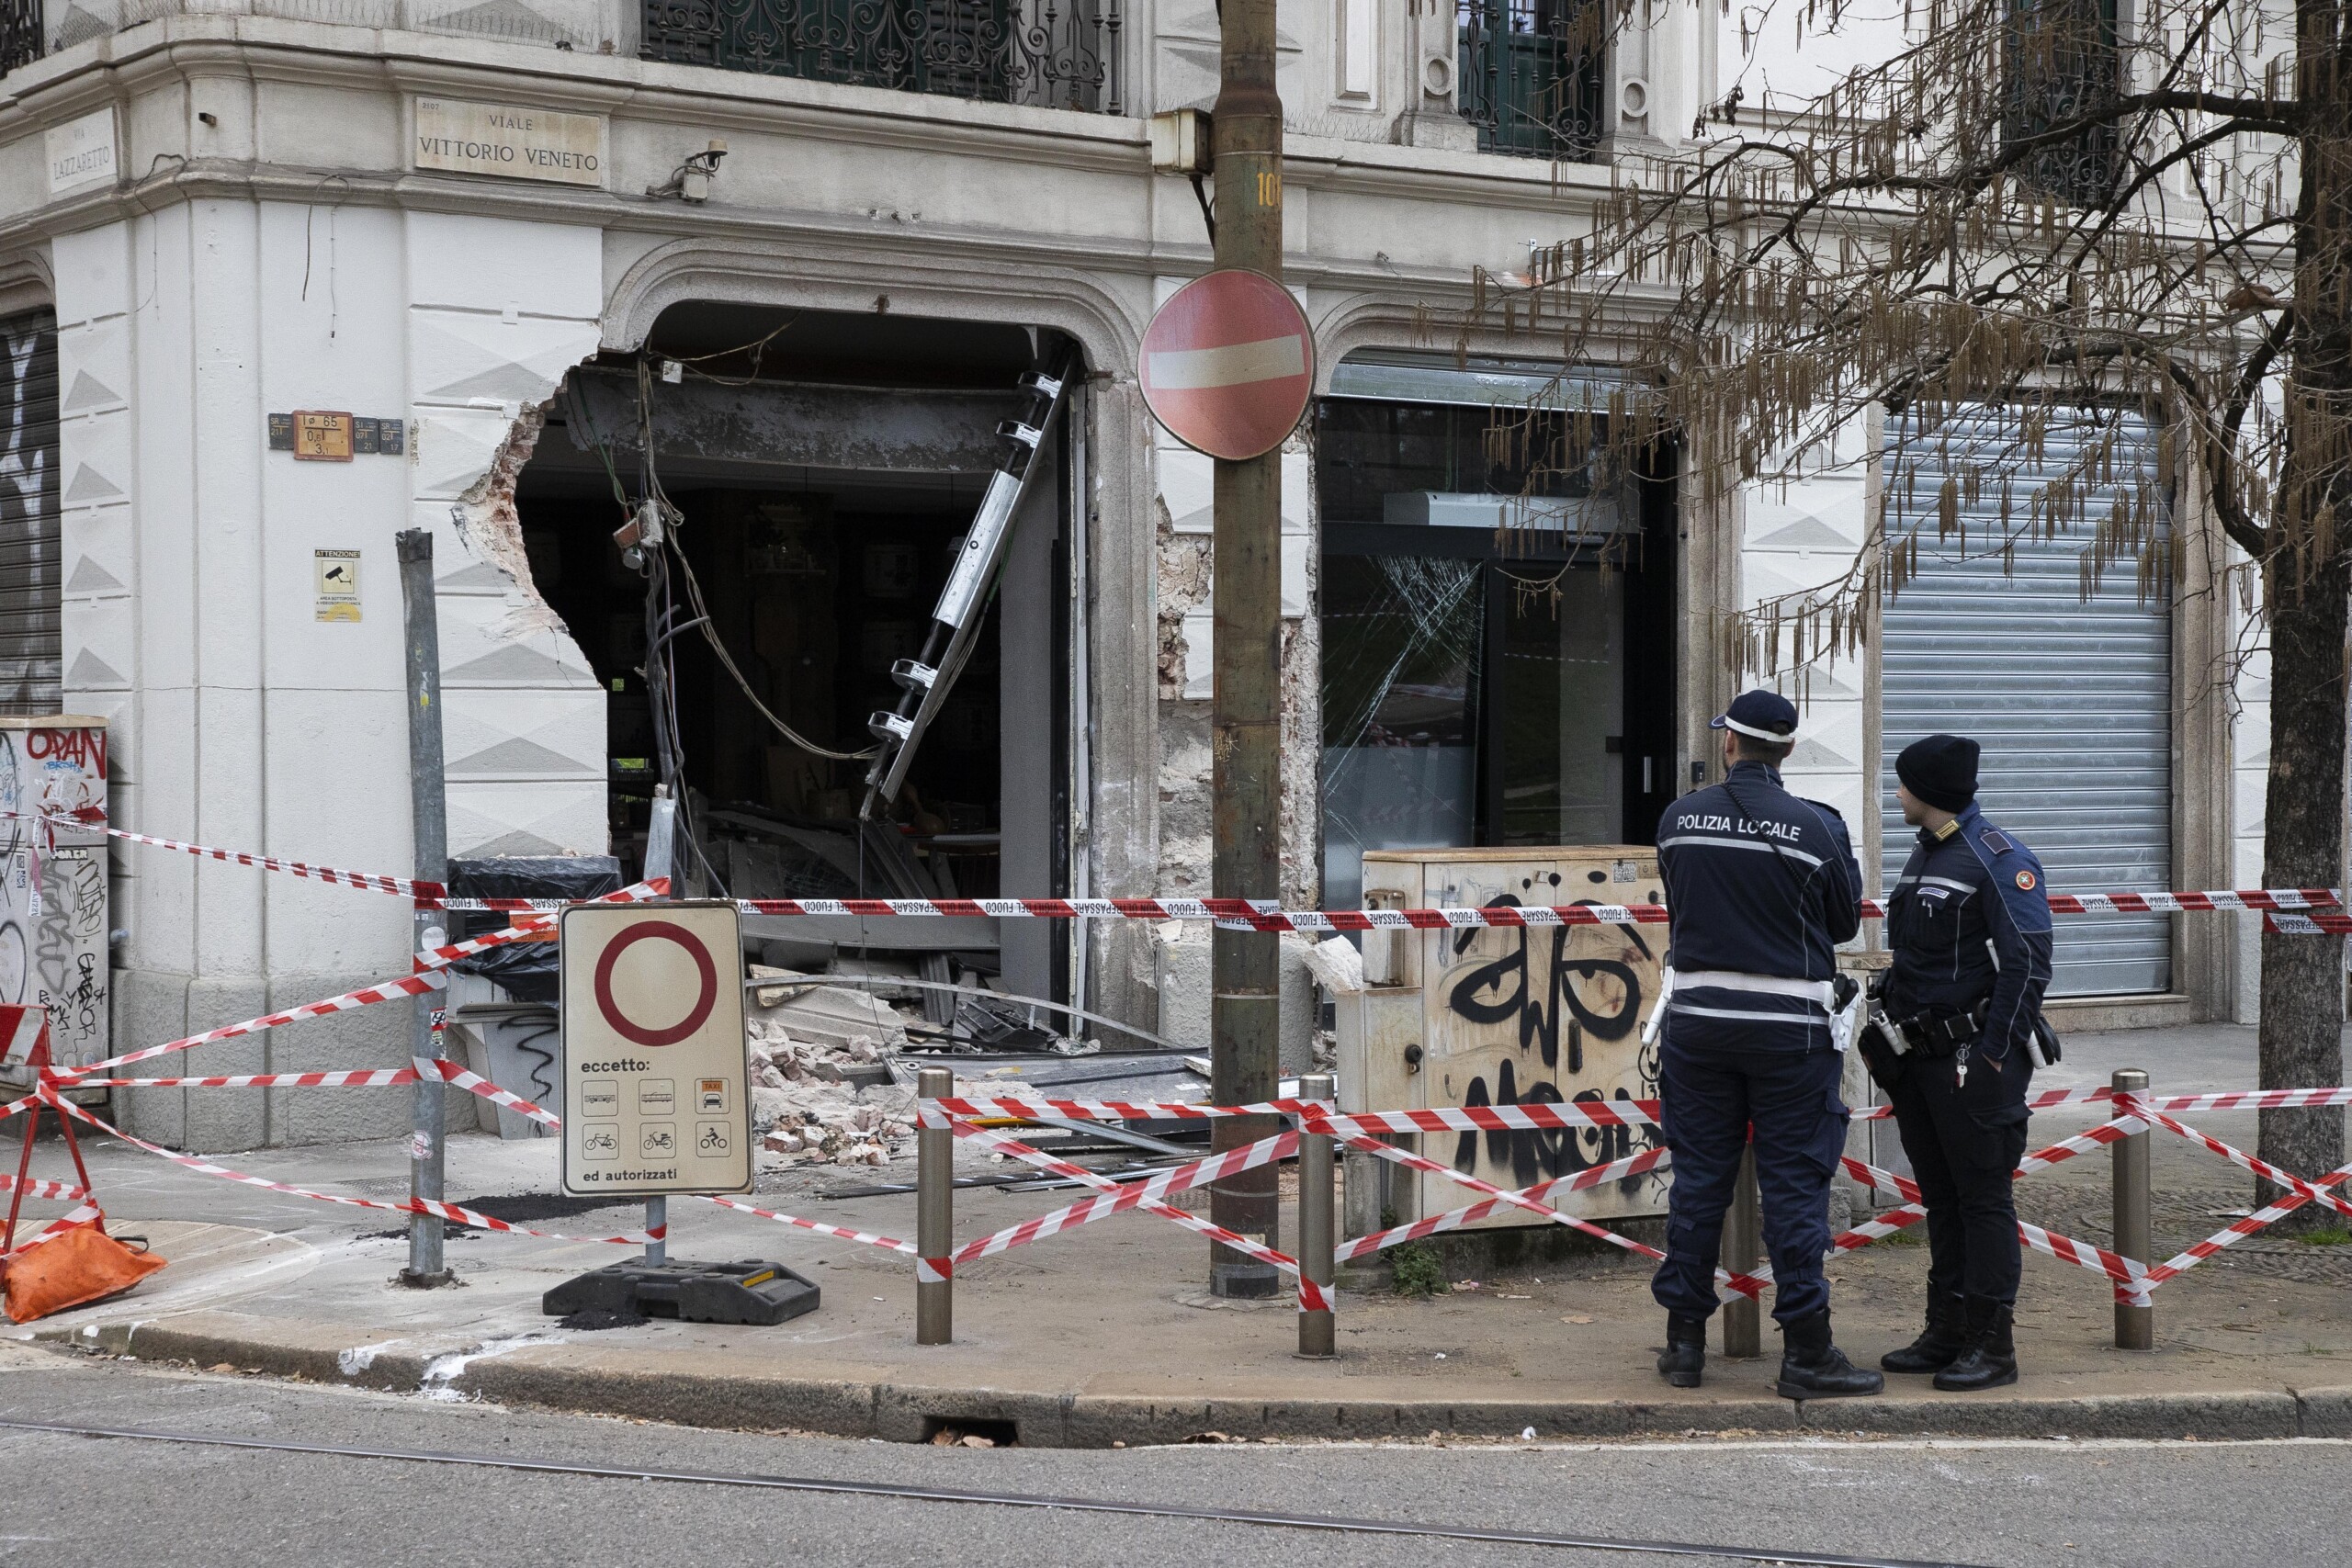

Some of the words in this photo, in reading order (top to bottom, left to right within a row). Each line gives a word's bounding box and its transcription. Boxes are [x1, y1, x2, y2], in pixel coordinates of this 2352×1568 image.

[489, 115, 533, 130] VIALE
[74, 129, 85, 140] VIA
[419, 136, 514, 163] VITTORIO
[525, 148, 598, 171] VENETO
[53, 145, 109, 180] LAZZARETTO
[270, 417, 279, 425] SR
[322, 416, 338, 427] 65
[1677, 814, 1731, 832] POLIZIA
[1737, 818, 1802, 842] LOCALE
[444, 898, 471, 908] FUOCO
[2082, 897, 2129, 909] OLTREPASSARE
[2149, 897, 2168, 908] FUOCO
[2169, 897, 2180, 907] DEL
[2276, 894, 2297, 904] FUOCO
[805, 901, 832, 912] FUOCO
[835, 901, 850, 912] DEL
[852, 901, 876, 912] VIGILI
[892, 901, 956, 913] OLTREPASSARE
[959, 901, 976, 912] NON
[986, 902, 1014, 913] FUOCO
[1016, 902, 1032, 913] DEL
[1034, 901, 1057, 912] VIGILI
[1074, 903, 1138, 914] OLTREPASSARE
[1141, 903, 1159, 913] NON
[1168, 903, 1196, 915] FUOCO
[1199, 904, 1215, 915] DEL
[1217, 905, 1240, 915] VIGILI
[1426, 912, 1442, 923] NON
[1449, 911, 1472, 924] FUOCO
[1475, 911, 1487, 923] DEL
[1488, 910, 1510, 921] VIGILI
[1522, 909, 1575, 922] OLTREPASSARE
[1576, 909, 1591, 921] NON
[1599, 908, 1622, 920] FUOCO
[1623, 908, 1635, 920] DEL
[1637, 908, 1657, 919] VIGILI
[1268, 916, 1284, 927] NON
[1293, 914, 1317, 926] FUOCO
[1319, 914, 1332, 926] DEL
[1335, 914, 1356, 925] VIGILI
[1370, 913, 1424, 926] OLTREPASSARE
[2276, 919, 2335, 931] OLTREPASSARE
[581, 1058, 650, 1073] eccetto:
[582, 1170, 599, 1182] ed
[605, 1168, 677, 1181] autorizzati
